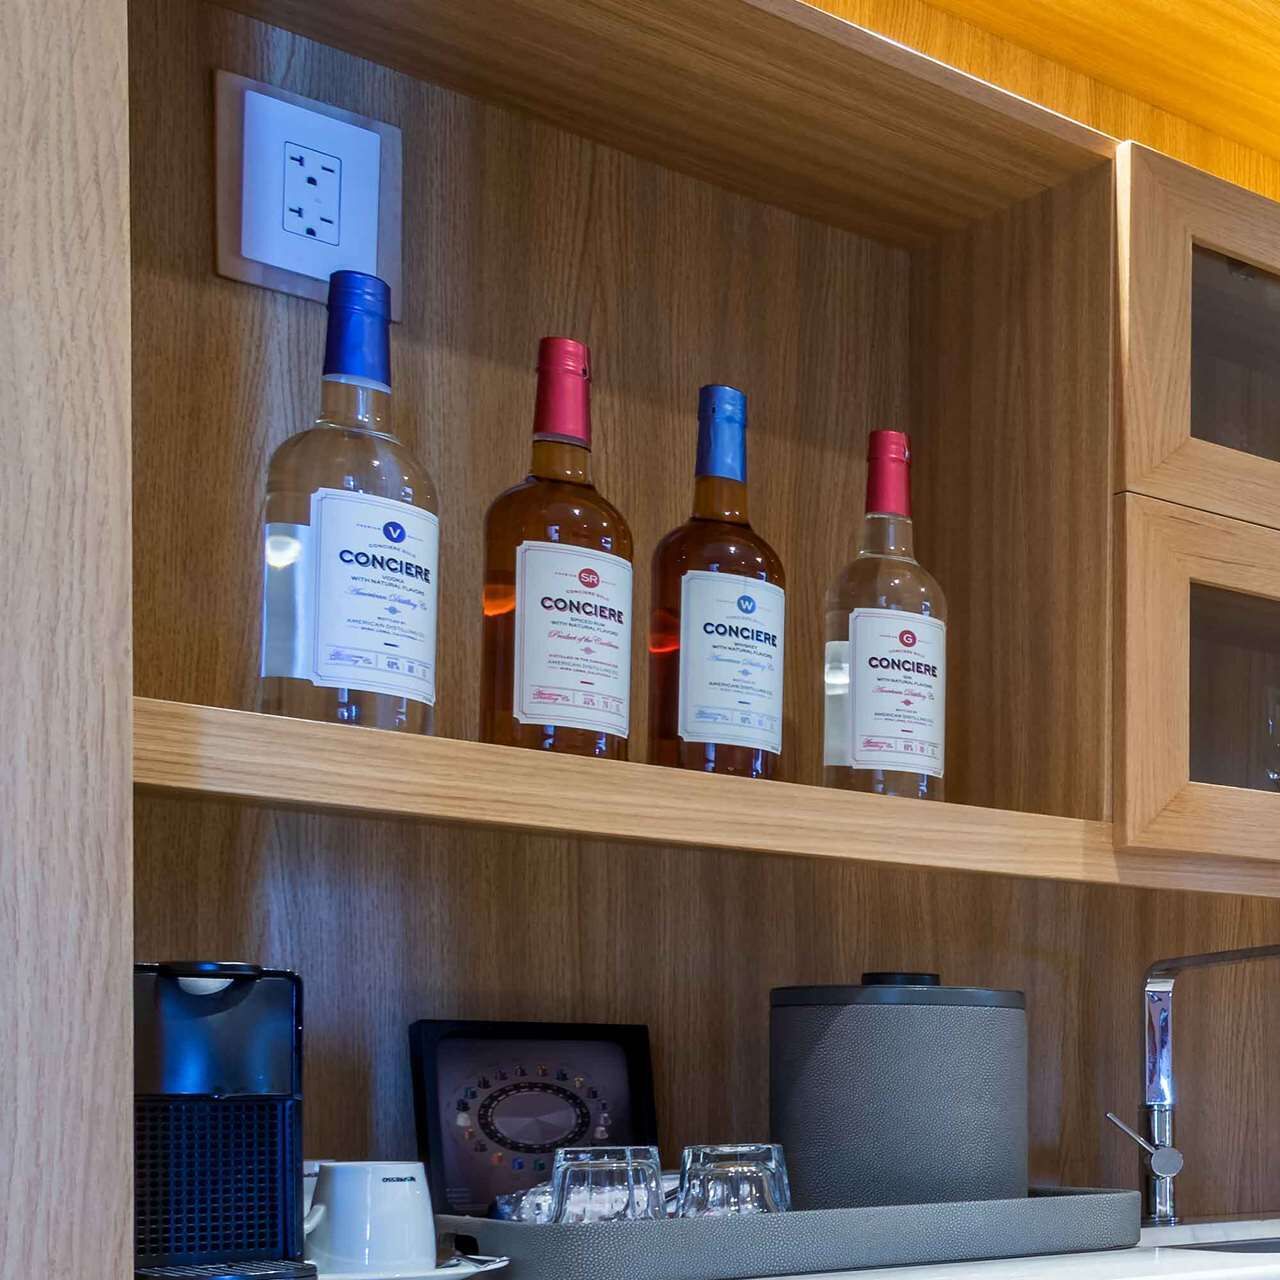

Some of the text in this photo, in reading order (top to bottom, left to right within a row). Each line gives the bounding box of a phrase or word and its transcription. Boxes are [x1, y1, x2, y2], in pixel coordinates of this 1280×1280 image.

[339, 549, 431, 584] CONCIERE
[581, 573, 598, 584] SR
[540, 596, 624, 625] CONCIERE
[703, 622, 777, 648] CONCIERE
[868, 656, 938, 678] CONCIERE
